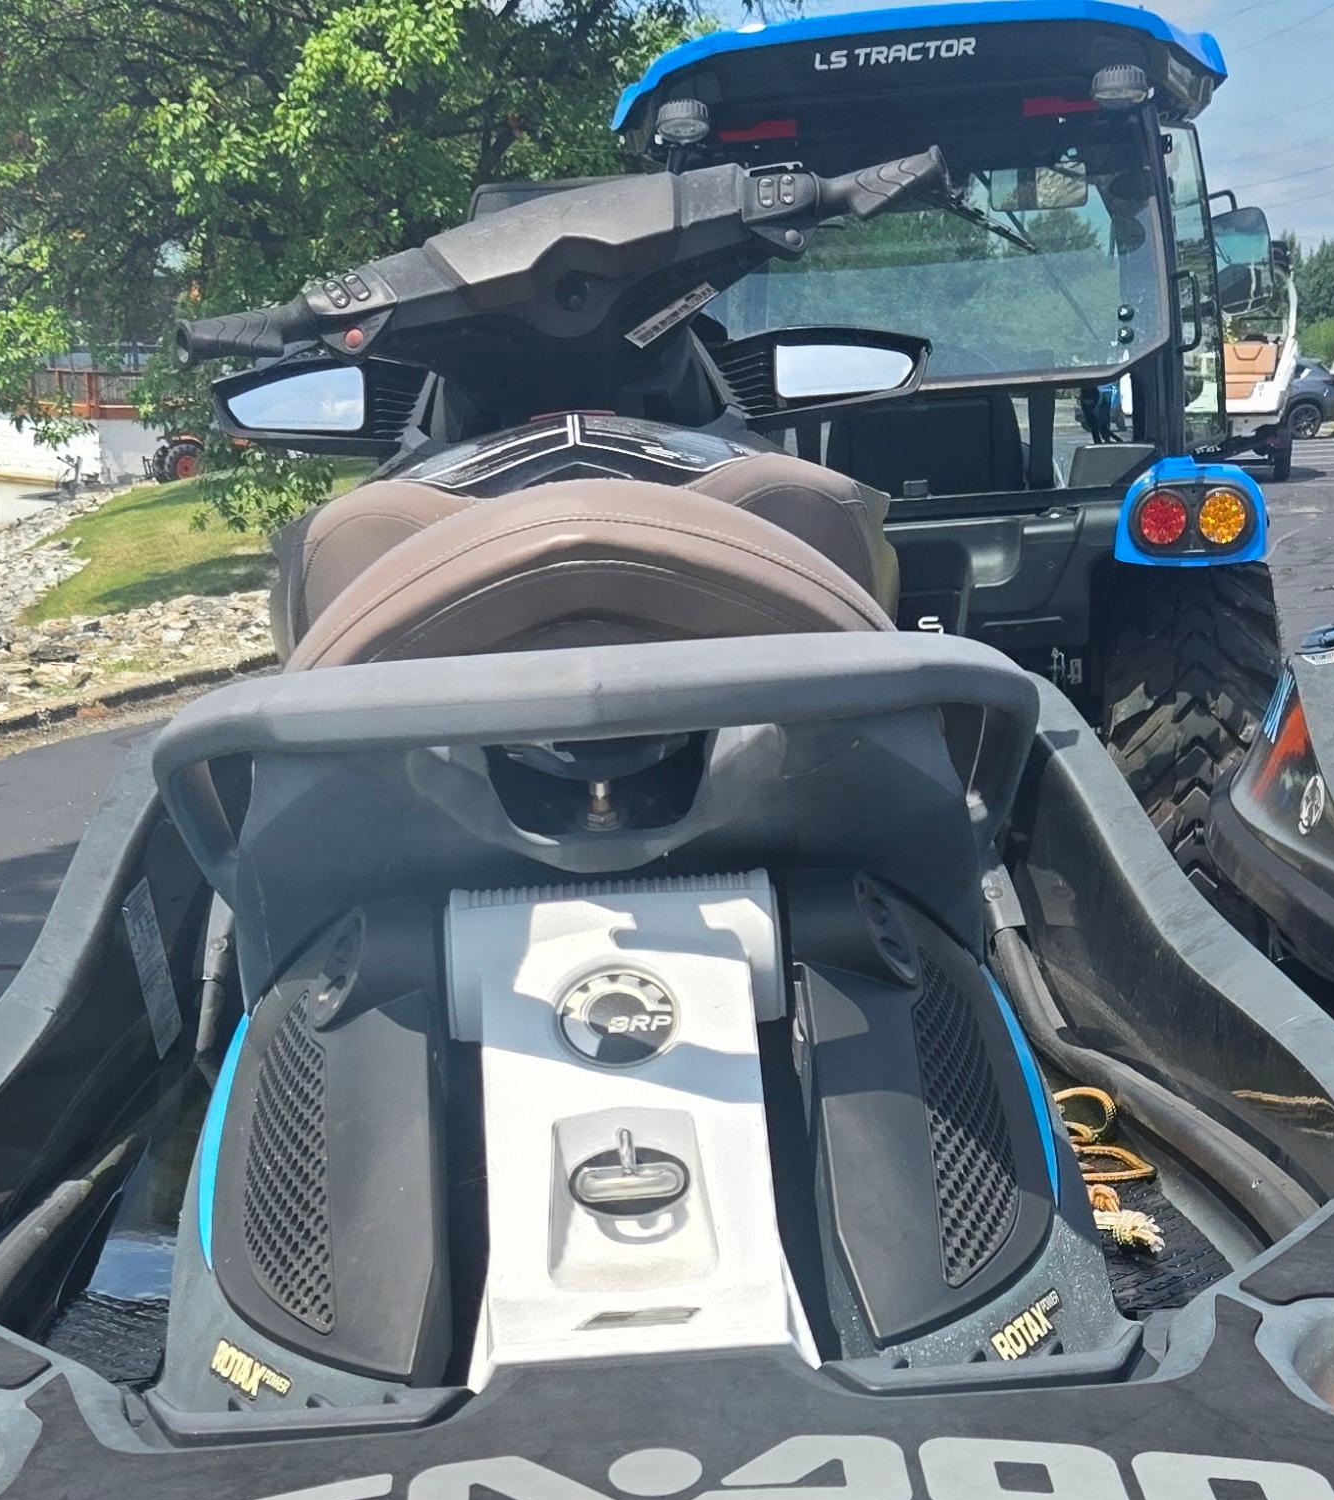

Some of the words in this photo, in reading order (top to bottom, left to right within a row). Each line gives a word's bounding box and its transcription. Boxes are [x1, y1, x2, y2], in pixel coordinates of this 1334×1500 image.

[814, 50, 848, 70] LS
[854, 37, 976, 66] TRACTOR
[608, 1014, 673, 1034] BRP
[991, 1302, 1053, 1361] ROTAX
[211, 1340, 265, 1397] ROTAX
